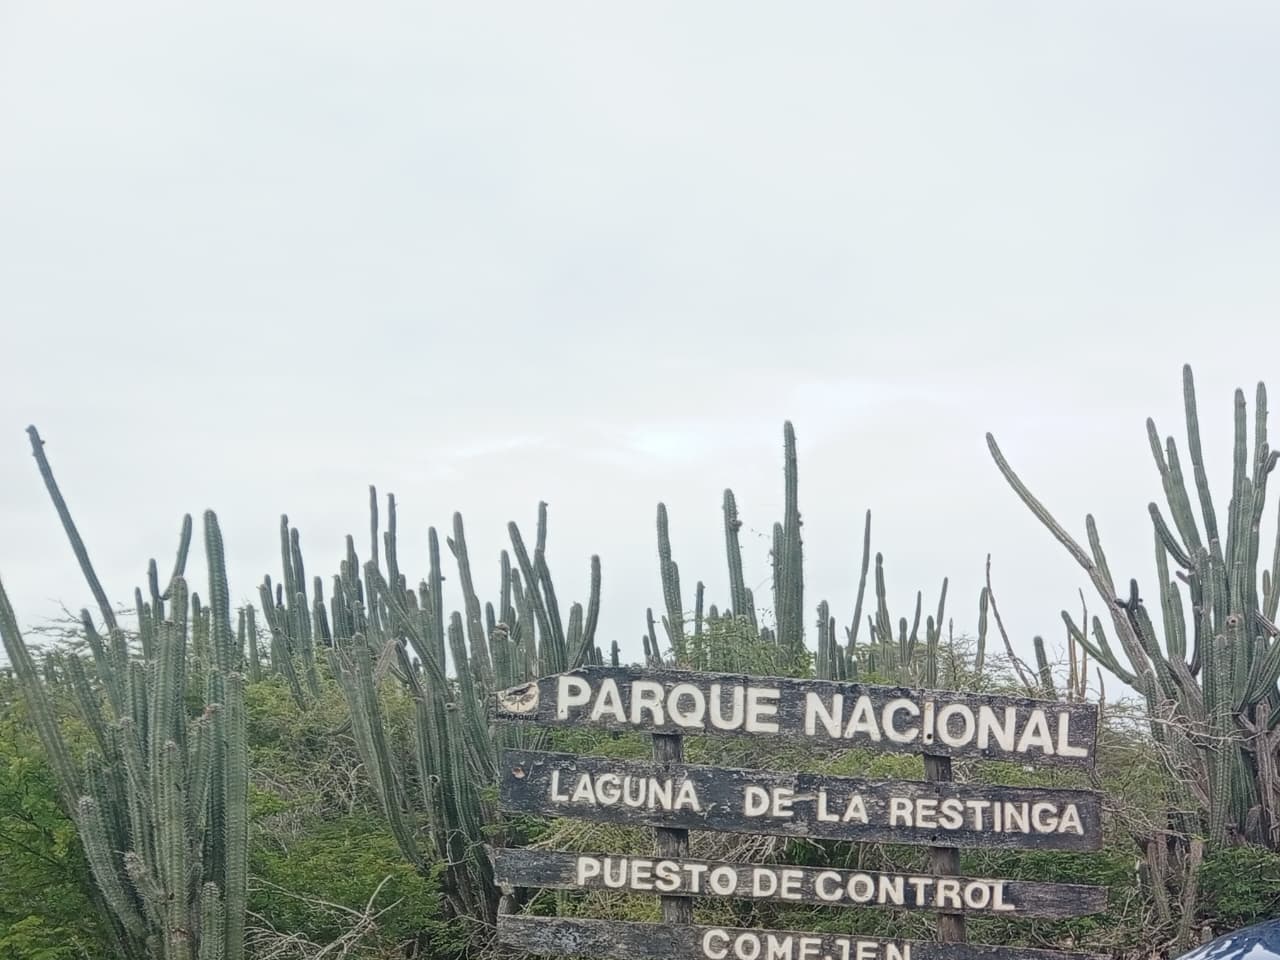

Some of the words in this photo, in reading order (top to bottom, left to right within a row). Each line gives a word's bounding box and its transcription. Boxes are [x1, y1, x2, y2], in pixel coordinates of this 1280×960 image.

[557, 675, 780, 733] PARQUE
[805, 692, 1089, 758] NACIONAL
[551, 770, 701, 812] LAGUNA
[744, 786, 794, 818] DE
[817, 792, 870, 824] LA
[889, 797, 1085, 836] RESTINGA
[577, 857, 738, 896] PUESTO
[753, 868, 804, 900] DE
[815, 870, 1016, 912] CONTROL
